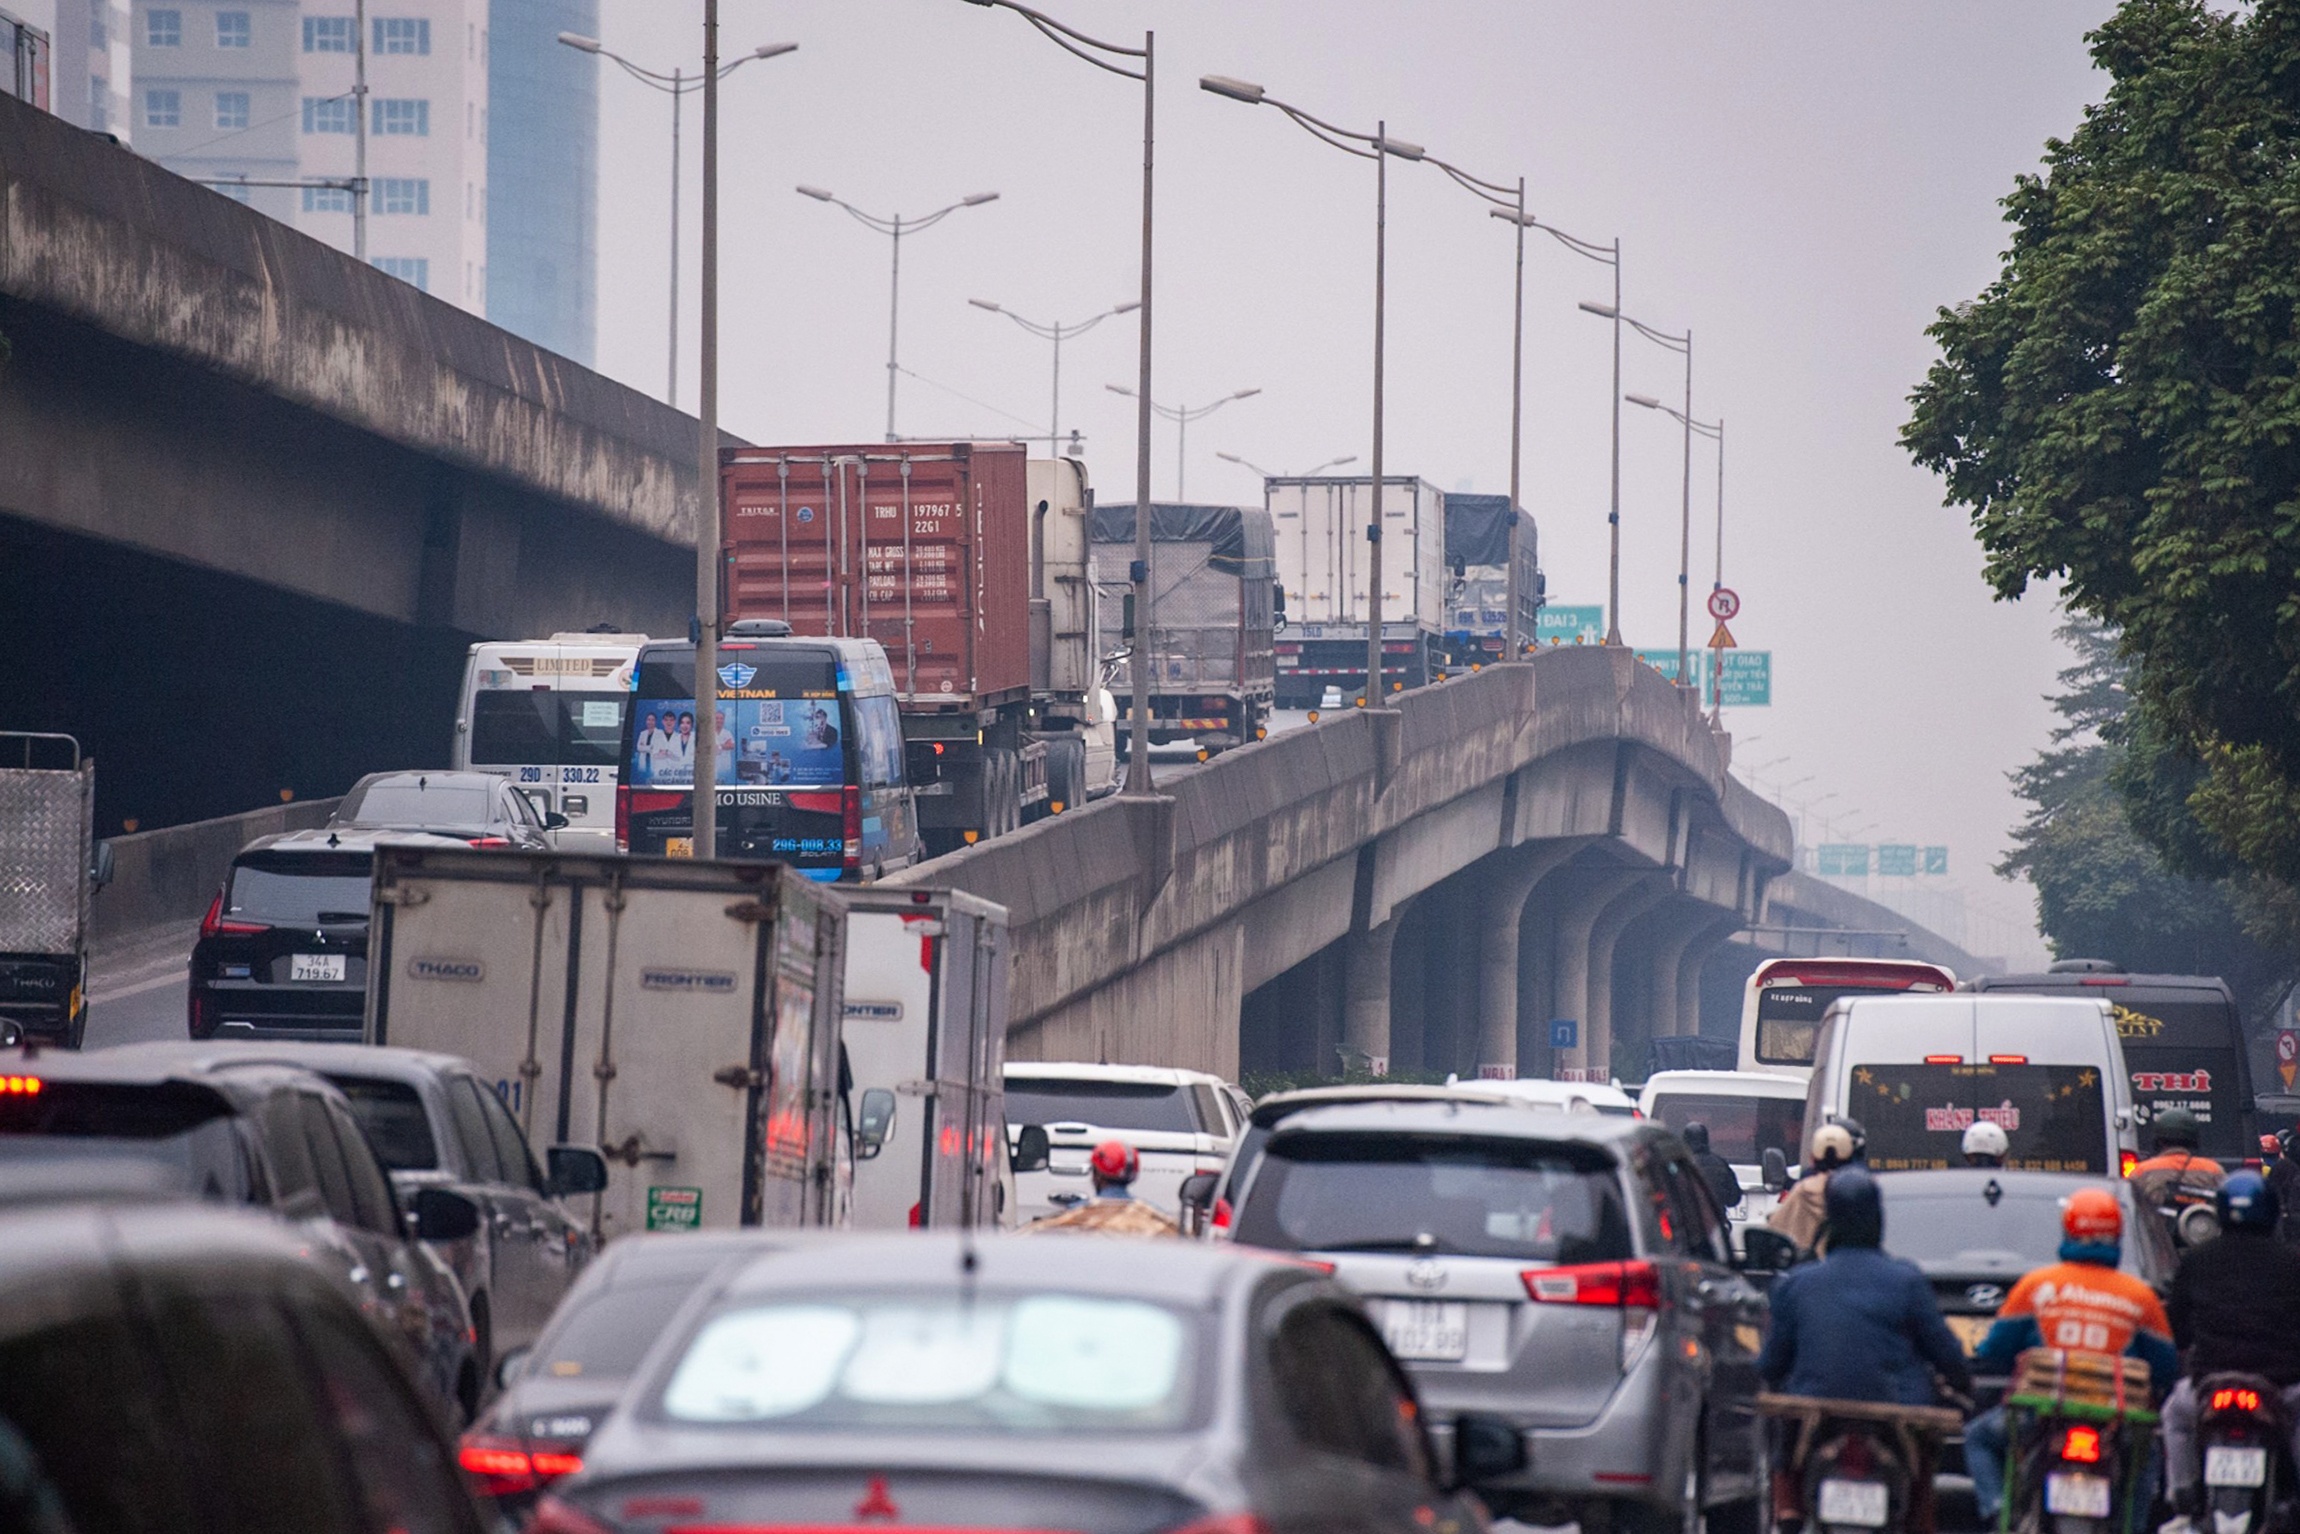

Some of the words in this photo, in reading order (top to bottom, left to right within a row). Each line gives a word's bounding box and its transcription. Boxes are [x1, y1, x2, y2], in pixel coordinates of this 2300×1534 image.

[875, 506, 897, 518] TRHU
[914, 505, 950, 517] 197967
[956, 504, 962, 517] 5
[915, 521, 939, 533] 22G1
[868, 547, 882, 558] MAX
[885, 546, 904, 558] GROSS
[869, 576, 896, 587] PAYLOAD
[1570, 614, 1577, 627] 3
[537, 660, 589, 671] LIMITED
[717, 689, 777, 699] VIETNAM
[520, 767, 541, 782] 29D
[563, 768, 599, 783] 330.22
[650, 816, 691, 825] HYUNDAI
[799, 850, 836, 858] SOLATI
[307, 955, 329, 967] 34A
[297, 968, 339, 979] 719.67
[415, 962, 480, 977] THACO
[643, 972, 734, 989] FRONTIER
